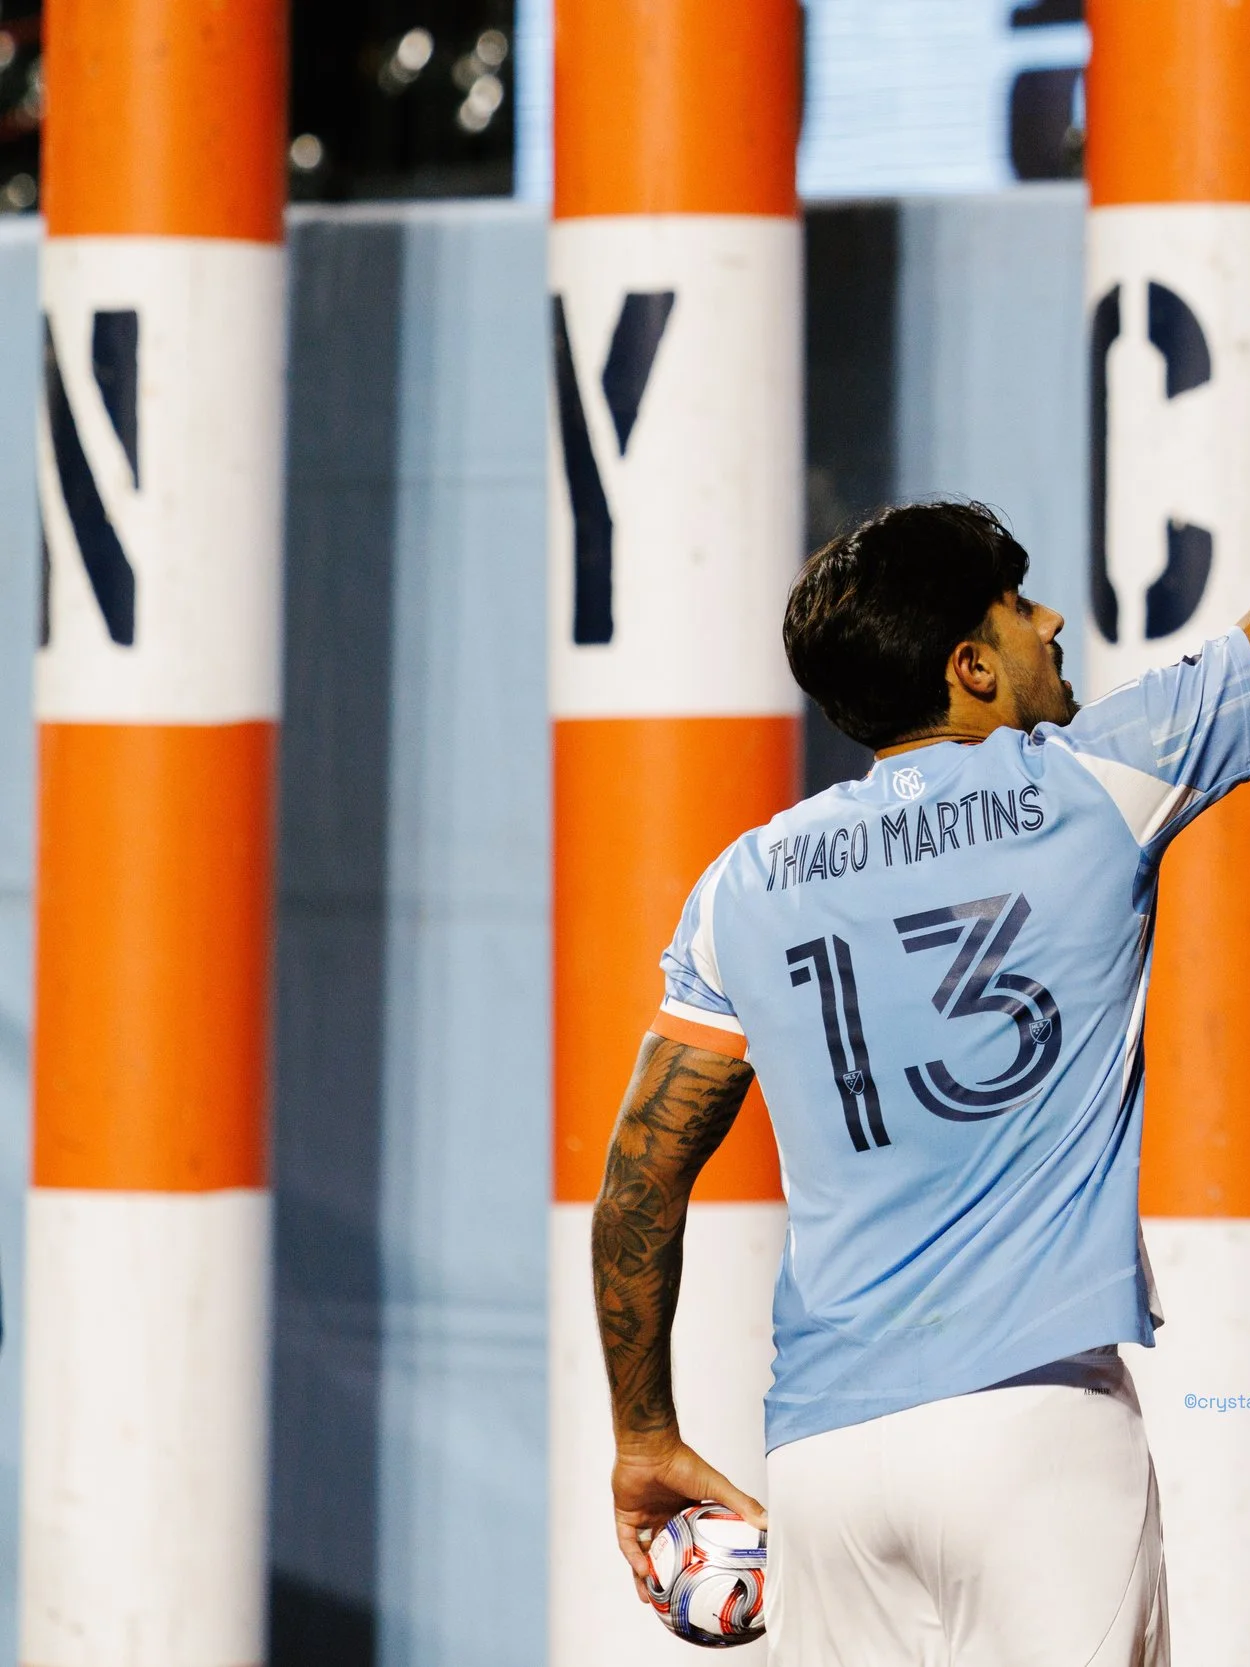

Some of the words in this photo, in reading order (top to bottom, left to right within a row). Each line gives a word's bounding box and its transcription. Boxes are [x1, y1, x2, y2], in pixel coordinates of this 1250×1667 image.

[38, 308, 139, 648] N
[549, 290, 675, 646] Y
[1089, 279, 1213, 644] C
[766, 820, 868, 892] THIAGO
[881, 785, 1044, 867] MARTINS
[785, 891, 1063, 1153] 13
